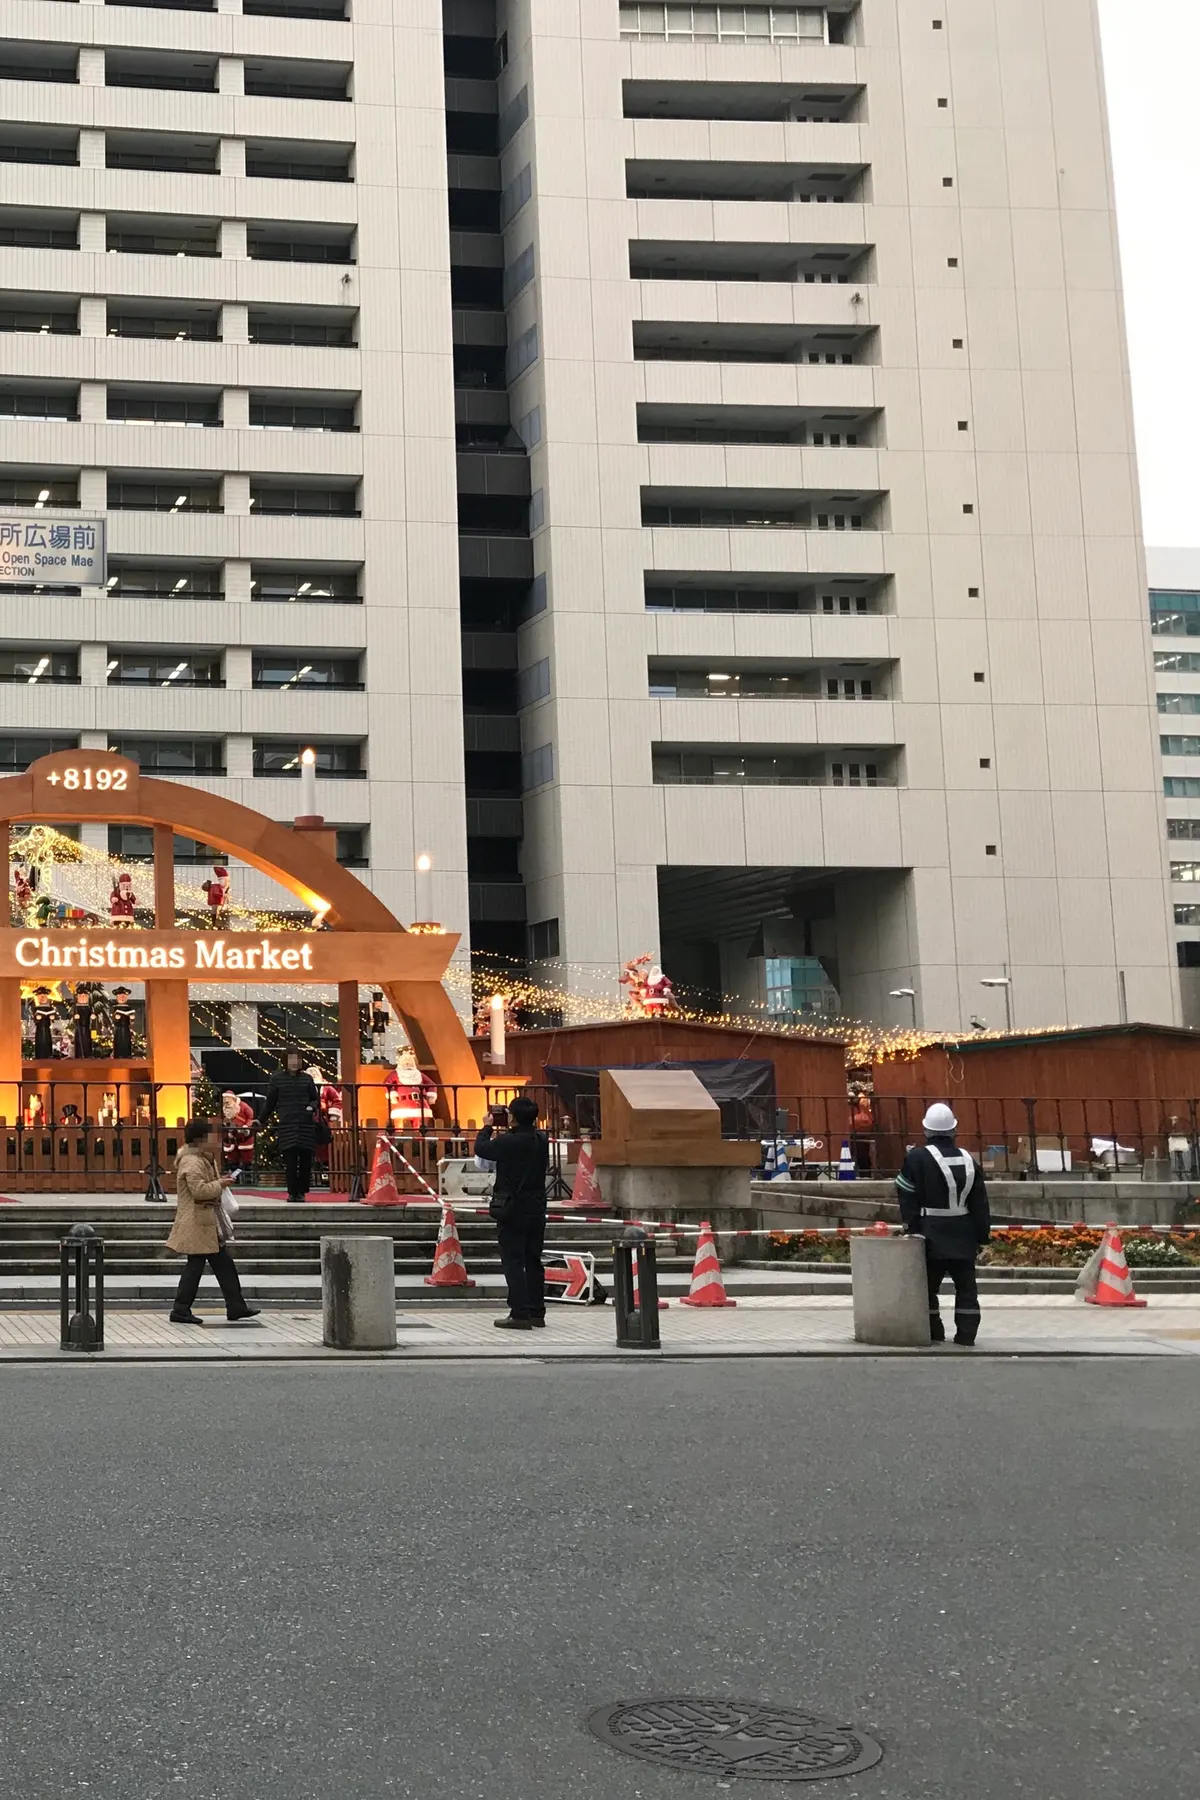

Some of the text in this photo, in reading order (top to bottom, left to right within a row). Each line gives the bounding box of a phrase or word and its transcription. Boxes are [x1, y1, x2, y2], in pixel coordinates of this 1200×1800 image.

[2, 552, 30, 566] Open
[34, 553, 67, 568] Space
[71, 554, 94, 567] Mae
[46, 768, 128, 791] +8192
[14, 936, 185, 969] Christmas
[194, 939, 314, 971] Market
